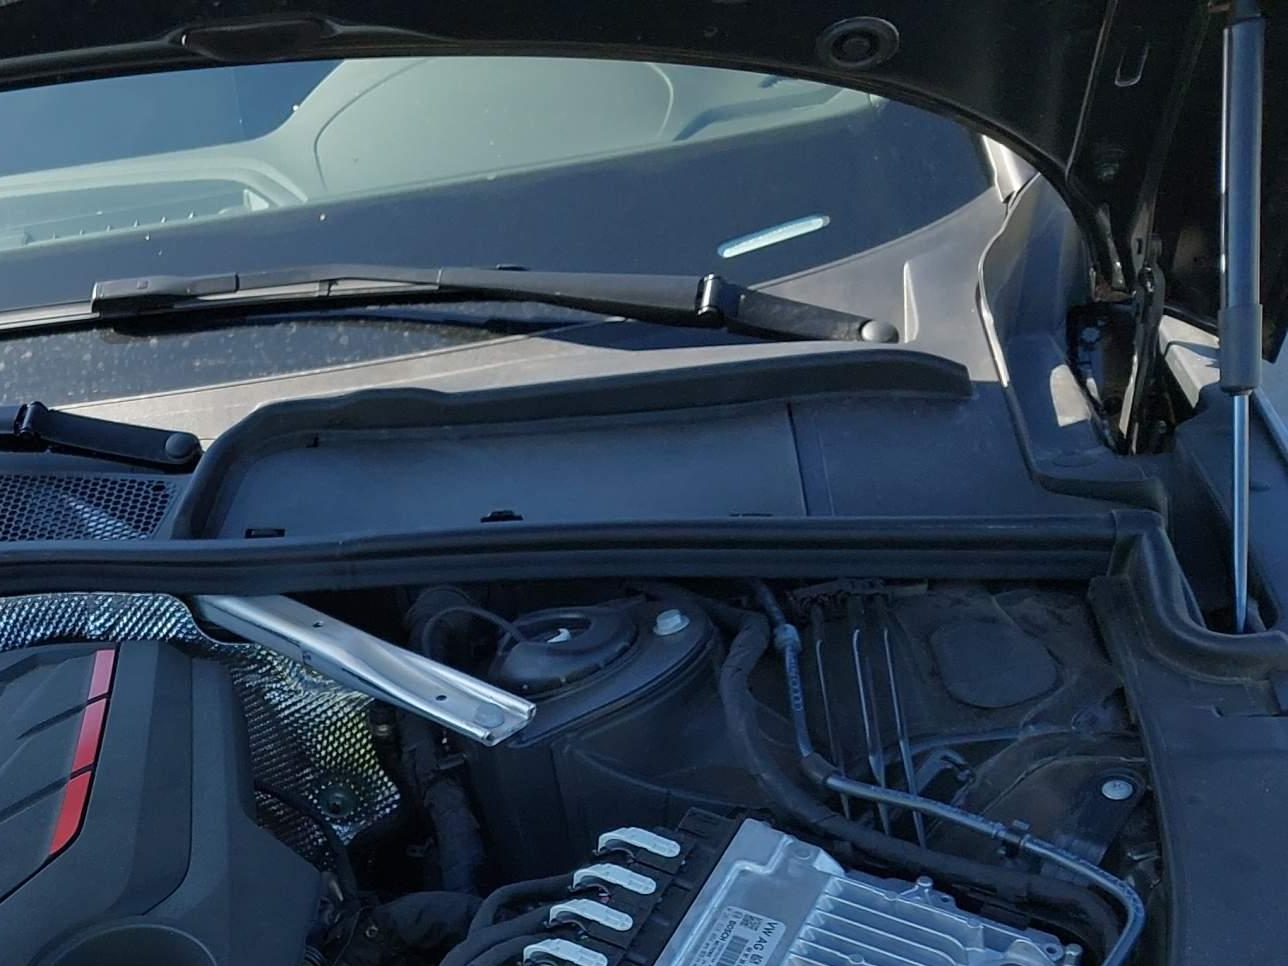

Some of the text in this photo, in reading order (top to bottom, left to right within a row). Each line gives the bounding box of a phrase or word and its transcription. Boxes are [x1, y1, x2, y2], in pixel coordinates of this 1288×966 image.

[718, 920, 736, 942] BOSCH
[762, 922, 778, 937] VW
[753, 936, 768, 951] AG
